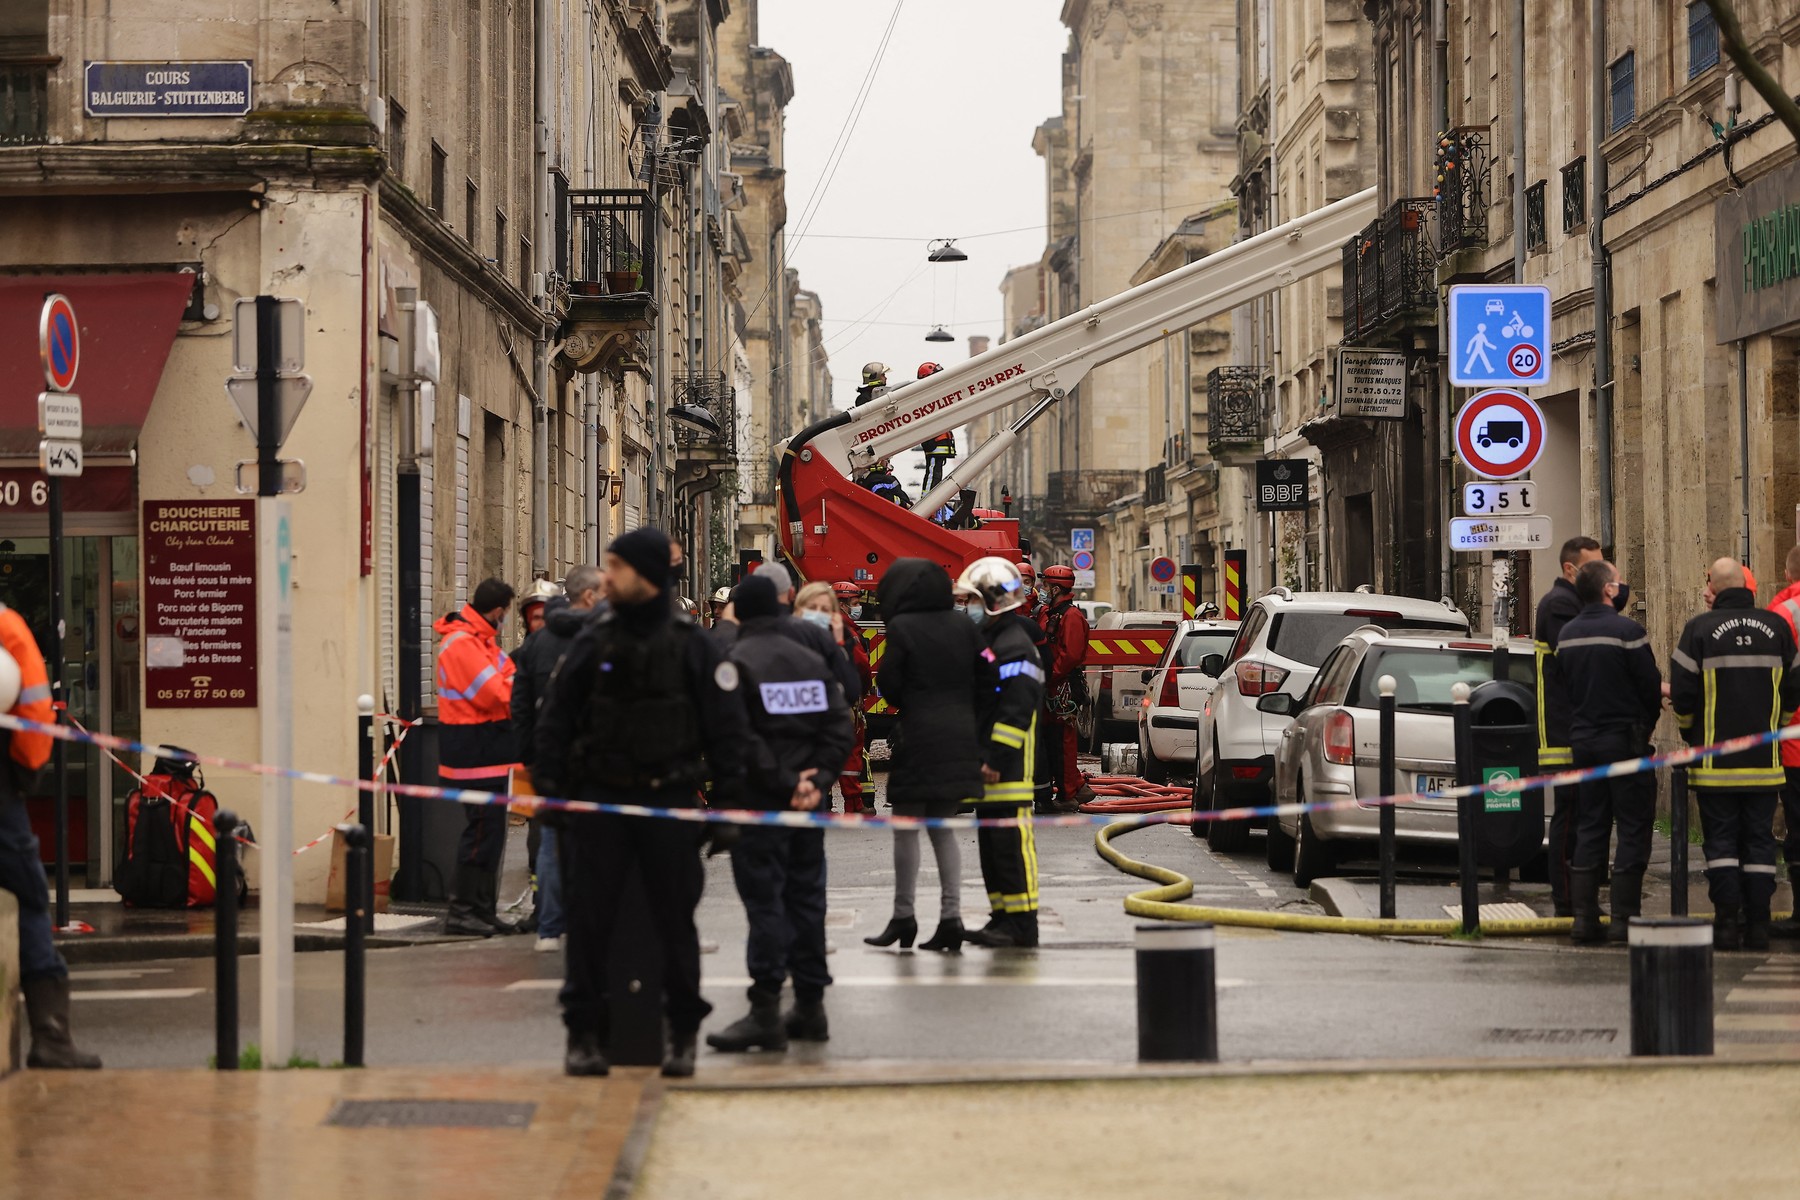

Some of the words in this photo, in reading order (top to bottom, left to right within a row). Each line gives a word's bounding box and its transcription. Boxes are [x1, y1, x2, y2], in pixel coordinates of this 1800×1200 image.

[146, 72, 190, 85] COURS
[1743, 203, 1800, 294] PHARMA
[1344, 357, 1367, 367] Garage
[1514, 354, 1534, 367] 20
[1347, 368, 1384, 376] REPARATIONS
[1375, 378, 1402, 386] MARQUES
[858, 413, 912, 443] BRONTO
[912, 390, 963, 420] SKYLIFT
[967, 384, 976, 396] F
[994, 363, 1026, 384] RPX
[0, 481, 20, 506] 0
[31, 480, 49, 506] 6
[1261, 484, 1303, 502] BBF
[1472, 488, 1510, 513] 3,5
[1520, 487, 1531, 508] t
[159, 506, 241, 519] BOUCHERIE
[150, 520, 250, 532] CHARCUTERIE
[165, 536, 183, 550] Chez
[185, 535, 204, 546] Jean
[206, 535, 235, 546] Claude
[169, 562, 194, 572] Bœuf
[194, 562, 232, 572] limousin
[149, 576, 171, 585] Veau
[172, 575, 196, 585] élevé
[197, 577, 219, 585] sous
[220, 575, 228, 585] la
[229, 575, 253, 585] mère
[174, 589, 195, 599] Porc
[196, 588, 228, 598] fermier
[157, 603, 179, 613] Porc
[180, 602, 198, 612] noir
[198, 602, 210, 612] de
[211, 602, 244, 614] Bigorre
[159, 616, 210, 626] Charcuterie
[210, 616, 243, 625] maison
[174, 627, 181, 636] à
[182, 626, 227, 636] l'ancienne
[200, 640, 242, 650] fermières
[1735, 635, 1753, 646] 33
[198, 654, 210, 663] de
[211, 653, 242, 663] Bresse
[157, 689, 173, 699] 05
[175, 689, 191, 699] 57
[193, 689, 209, 699] 87
[211, 689, 227, 699] 50
[229, 689, 246, 699] 69
[766, 686, 821, 707] POLICE
